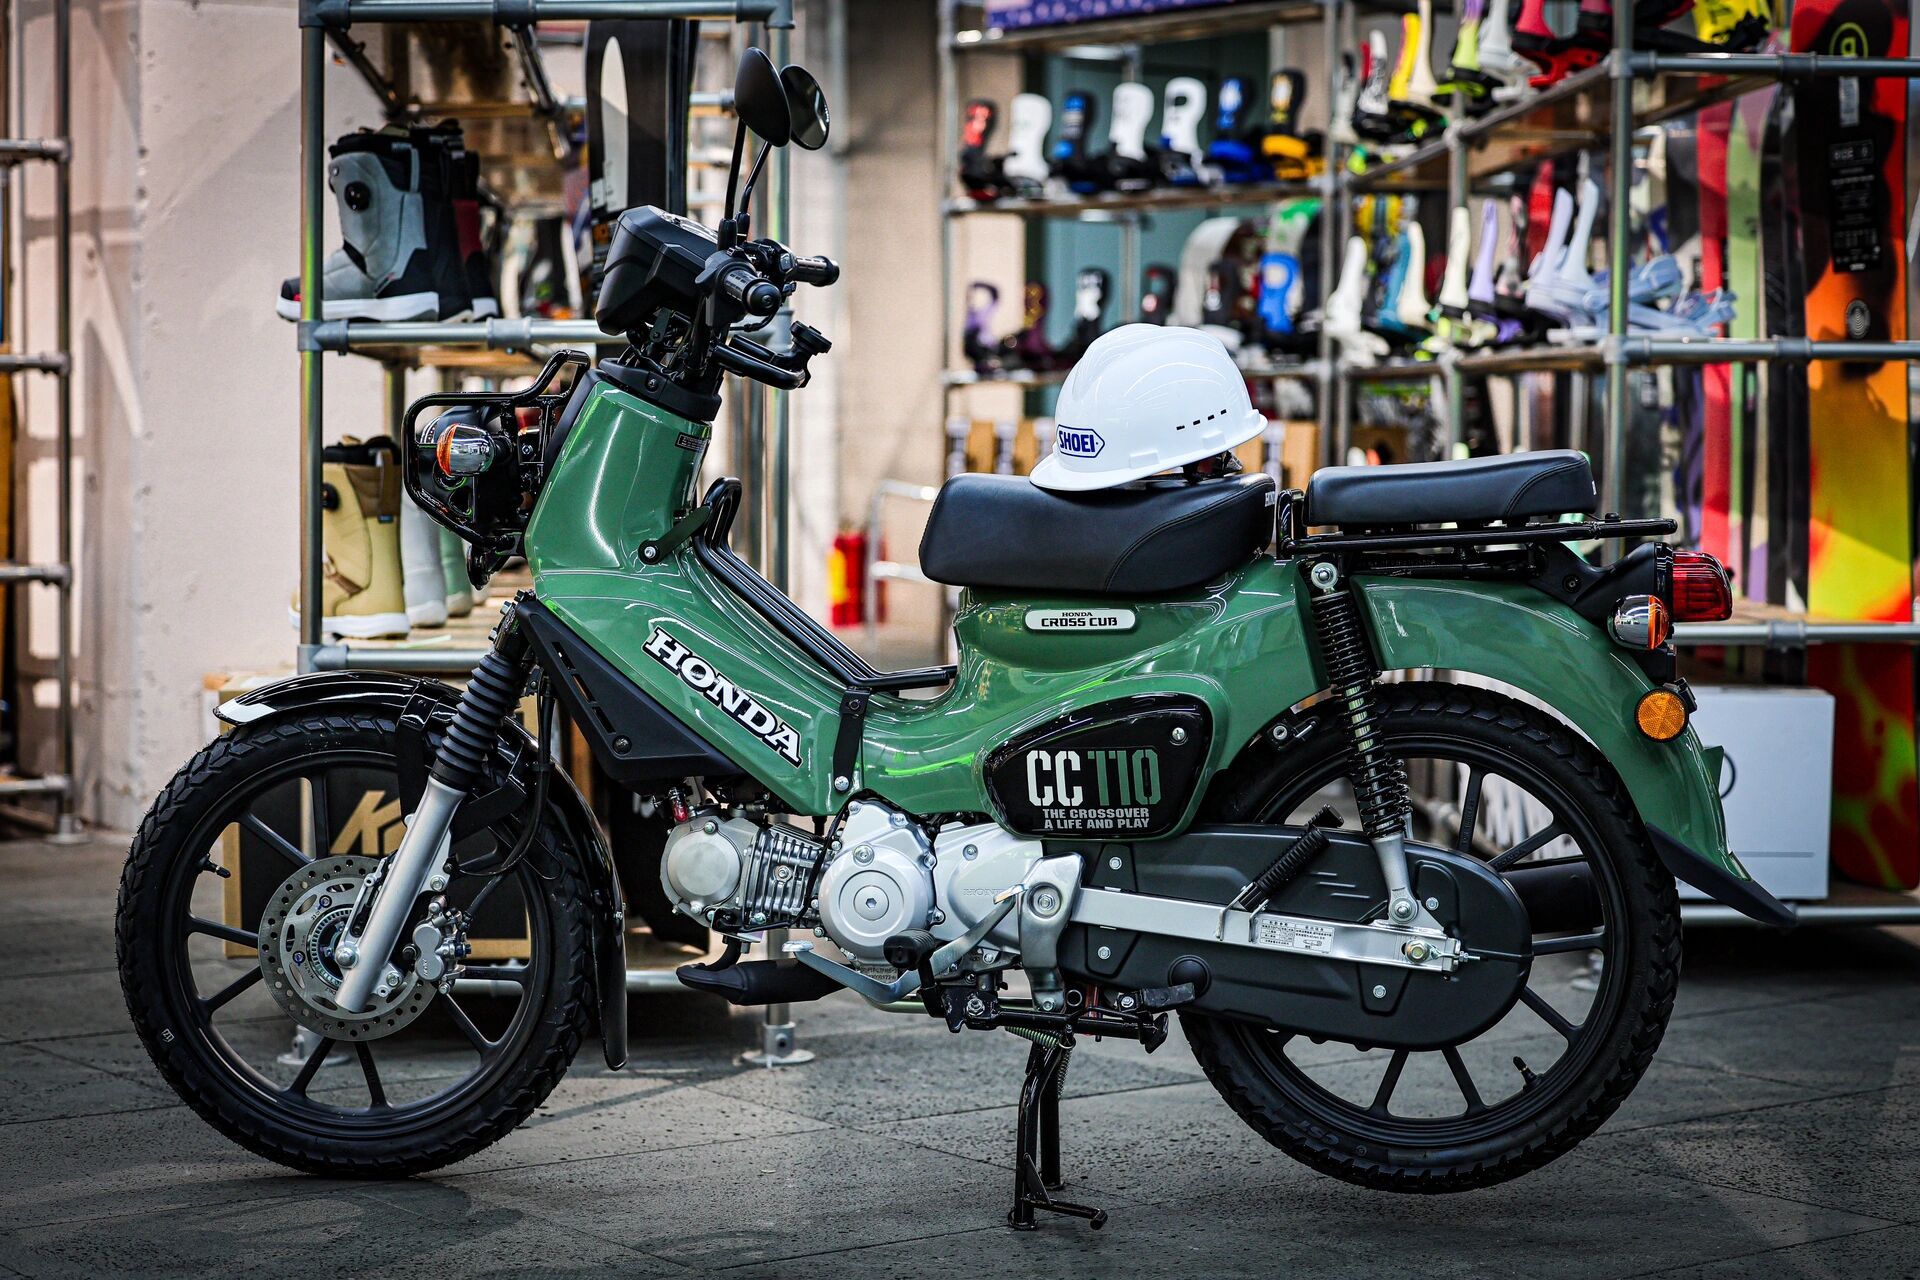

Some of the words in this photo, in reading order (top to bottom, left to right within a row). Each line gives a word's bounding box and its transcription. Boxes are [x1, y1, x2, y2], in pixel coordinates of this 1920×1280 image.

[1058, 430, 1096, 453] SHOEI
[1041, 617, 1086, 627] CROSS
[1089, 617, 1118, 626] CUB
[643, 627, 802, 767] HONDA
[1042, 808, 1066, 819] THE
[1069, 807, 1150, 819] CROSSOVER
[1044, 819, 1054, 829] A
[1056, 819, 1083, 829] LIFE
[1087, 819, 1114, 829] AND
[1117, 818, 1150, 829] PLAY
